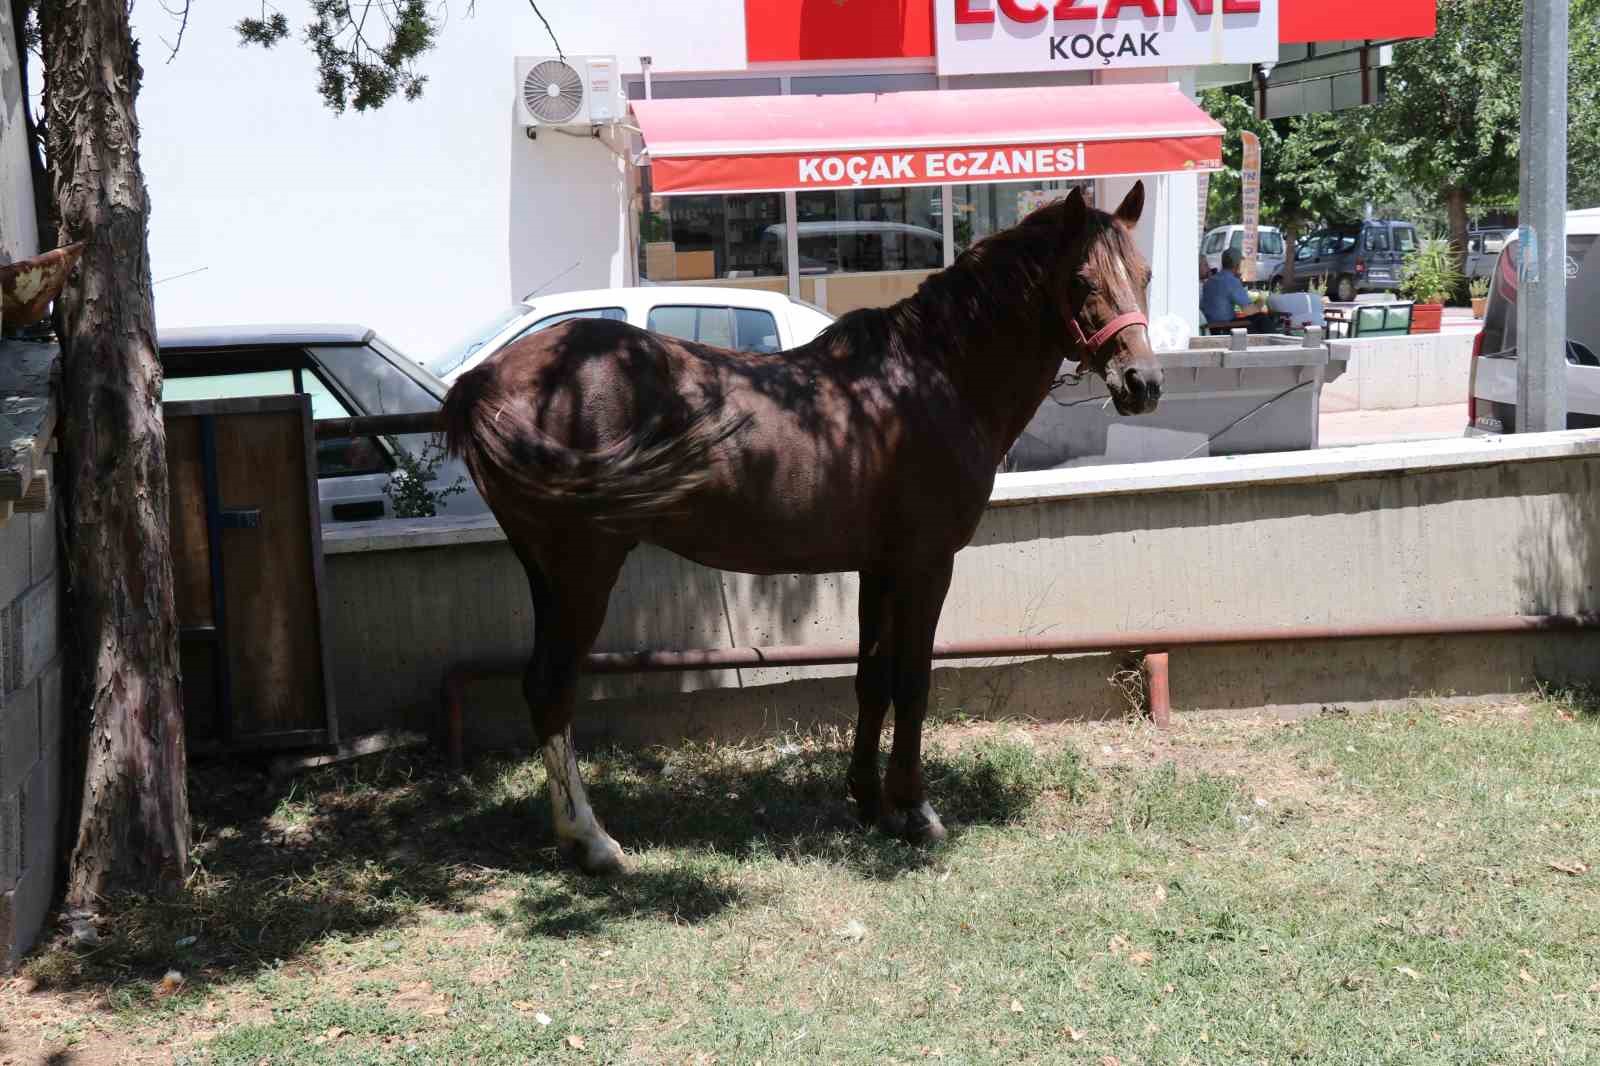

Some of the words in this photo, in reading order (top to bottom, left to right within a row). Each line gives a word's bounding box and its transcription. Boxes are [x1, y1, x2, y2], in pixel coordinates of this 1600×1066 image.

[1049, 32, 1160, 65] KOÇAK
[799, 154, 917, 186] KOÇAK
[925, 142, 1085, 177] ECZANESİ
